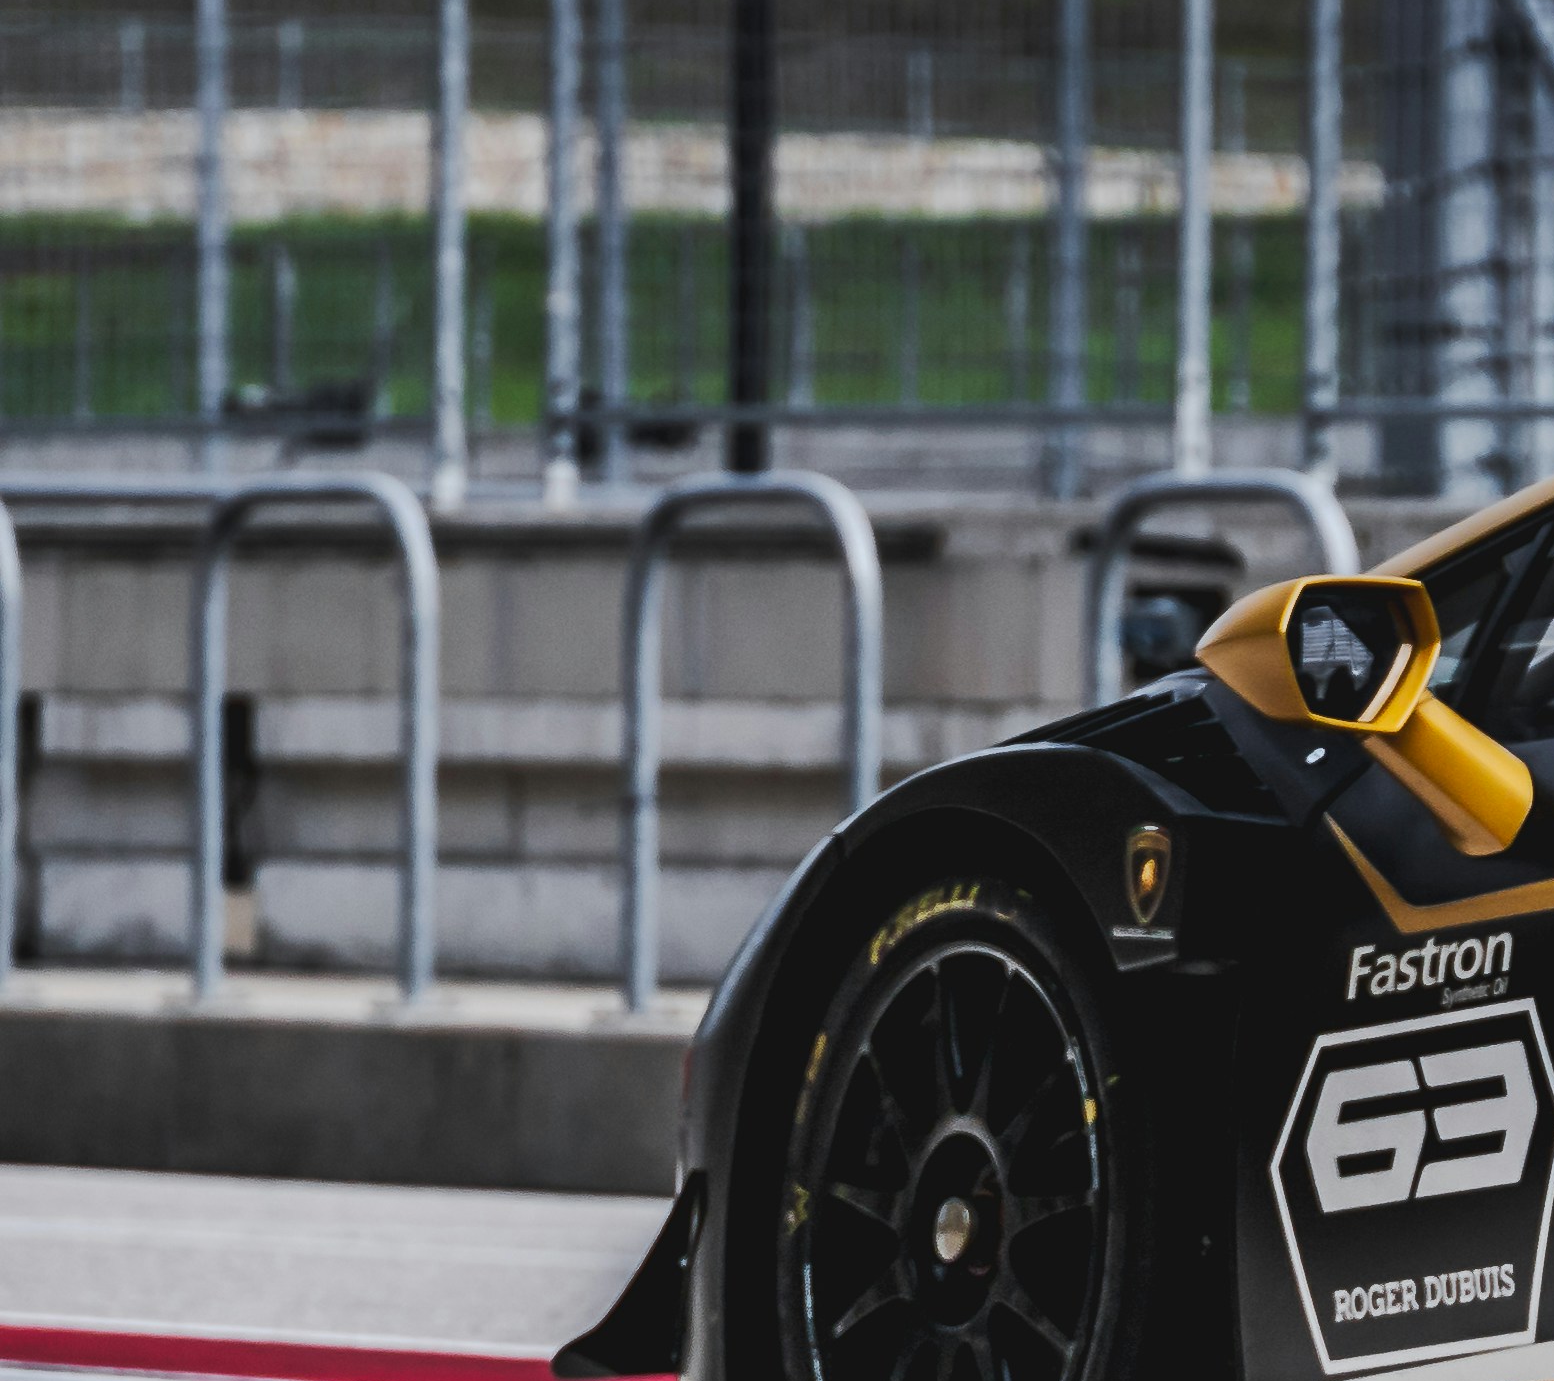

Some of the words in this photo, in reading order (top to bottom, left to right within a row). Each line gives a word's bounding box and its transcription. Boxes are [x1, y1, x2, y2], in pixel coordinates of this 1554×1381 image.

[1347, 931, 1513, 1000] Fastron
[1306, 1040, 1538, 1213] 63
[1333, 1279, 1419, 1322] ROGER
[1424, 1263, 1515, 1309] DUBUIS
